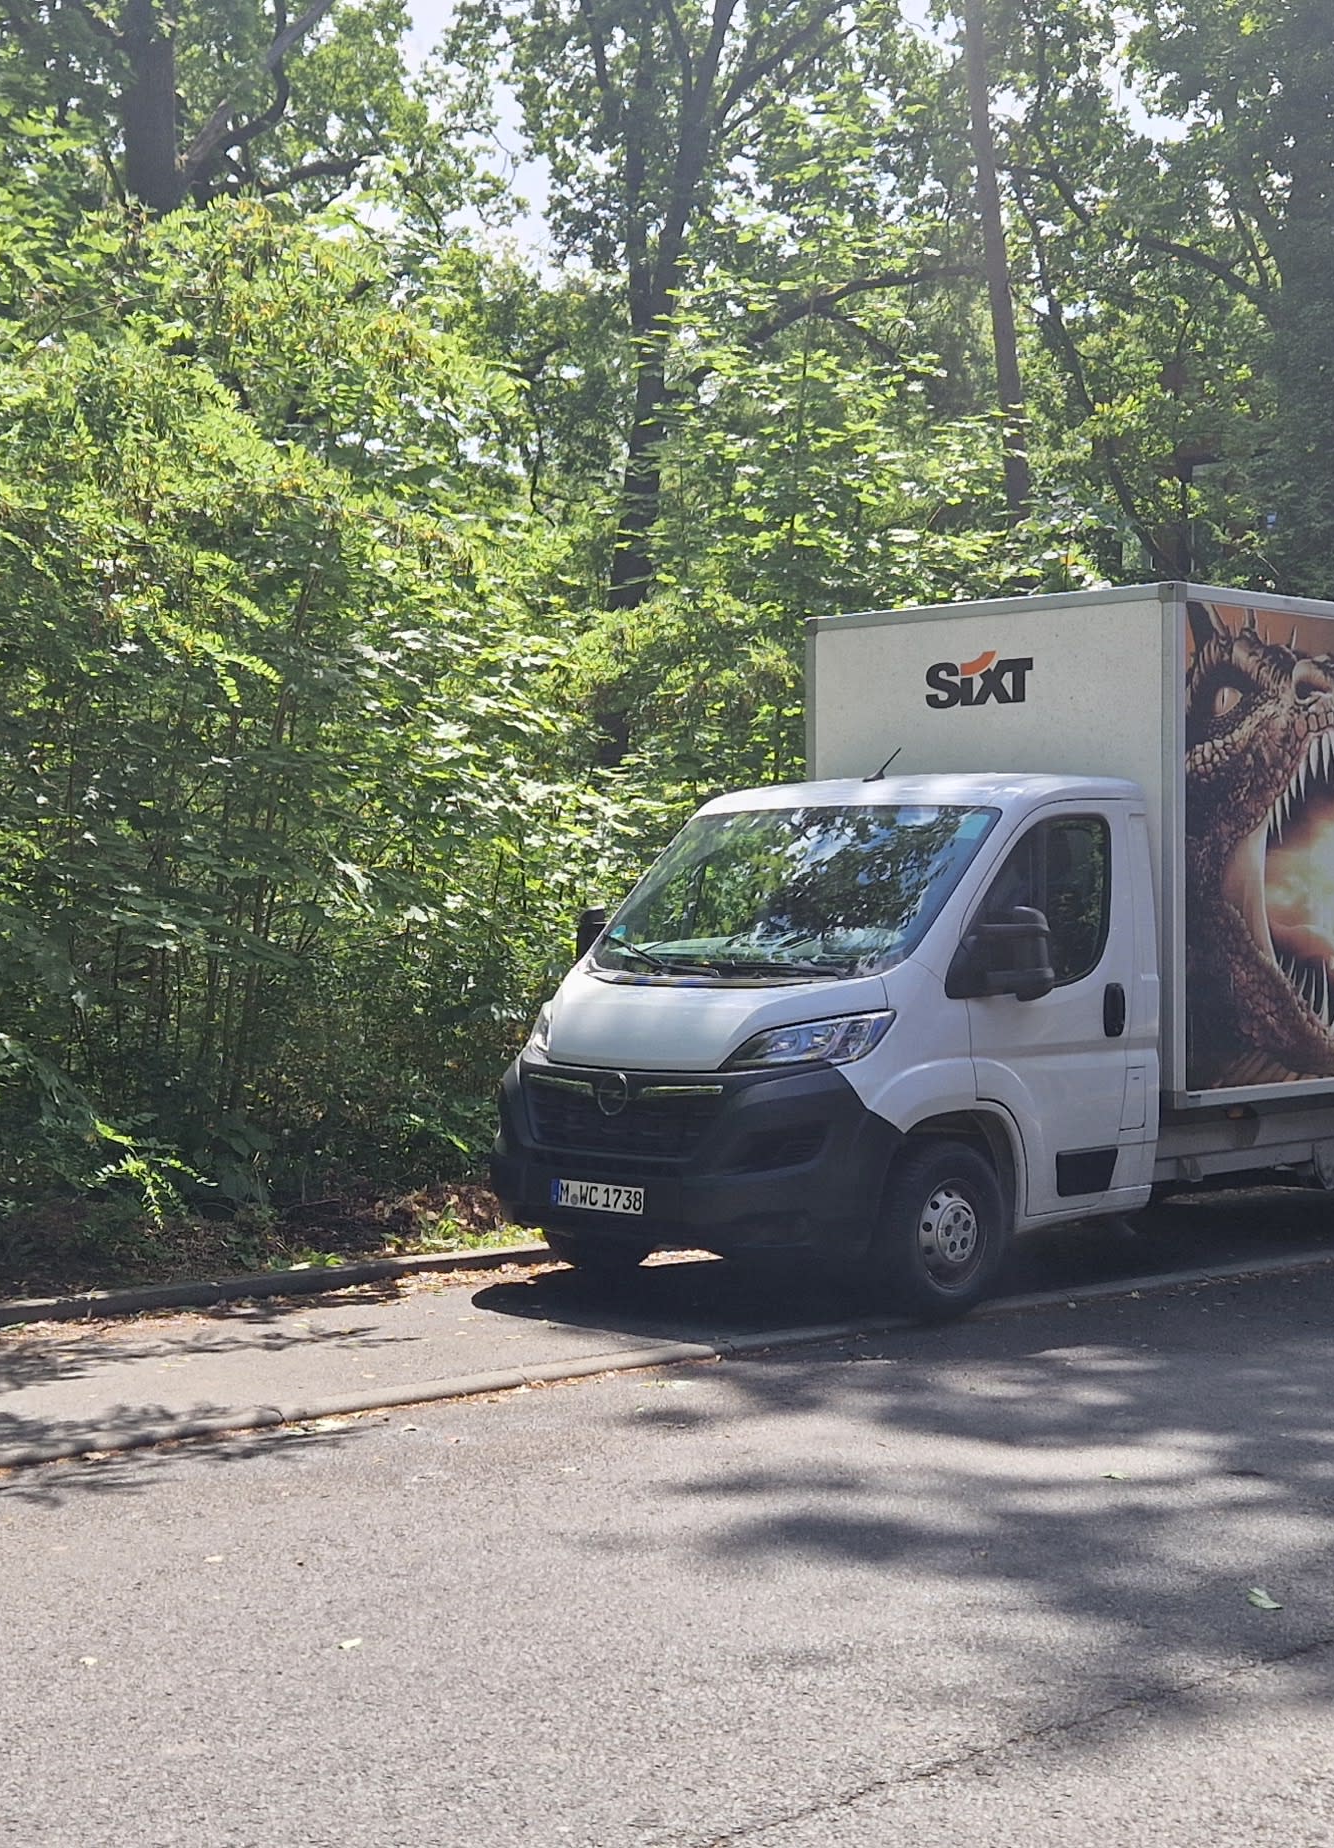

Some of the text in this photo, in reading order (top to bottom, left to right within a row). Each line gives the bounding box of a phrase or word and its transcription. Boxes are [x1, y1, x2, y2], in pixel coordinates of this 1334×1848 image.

[559, 1182, 643, 1212] M WC 1738
